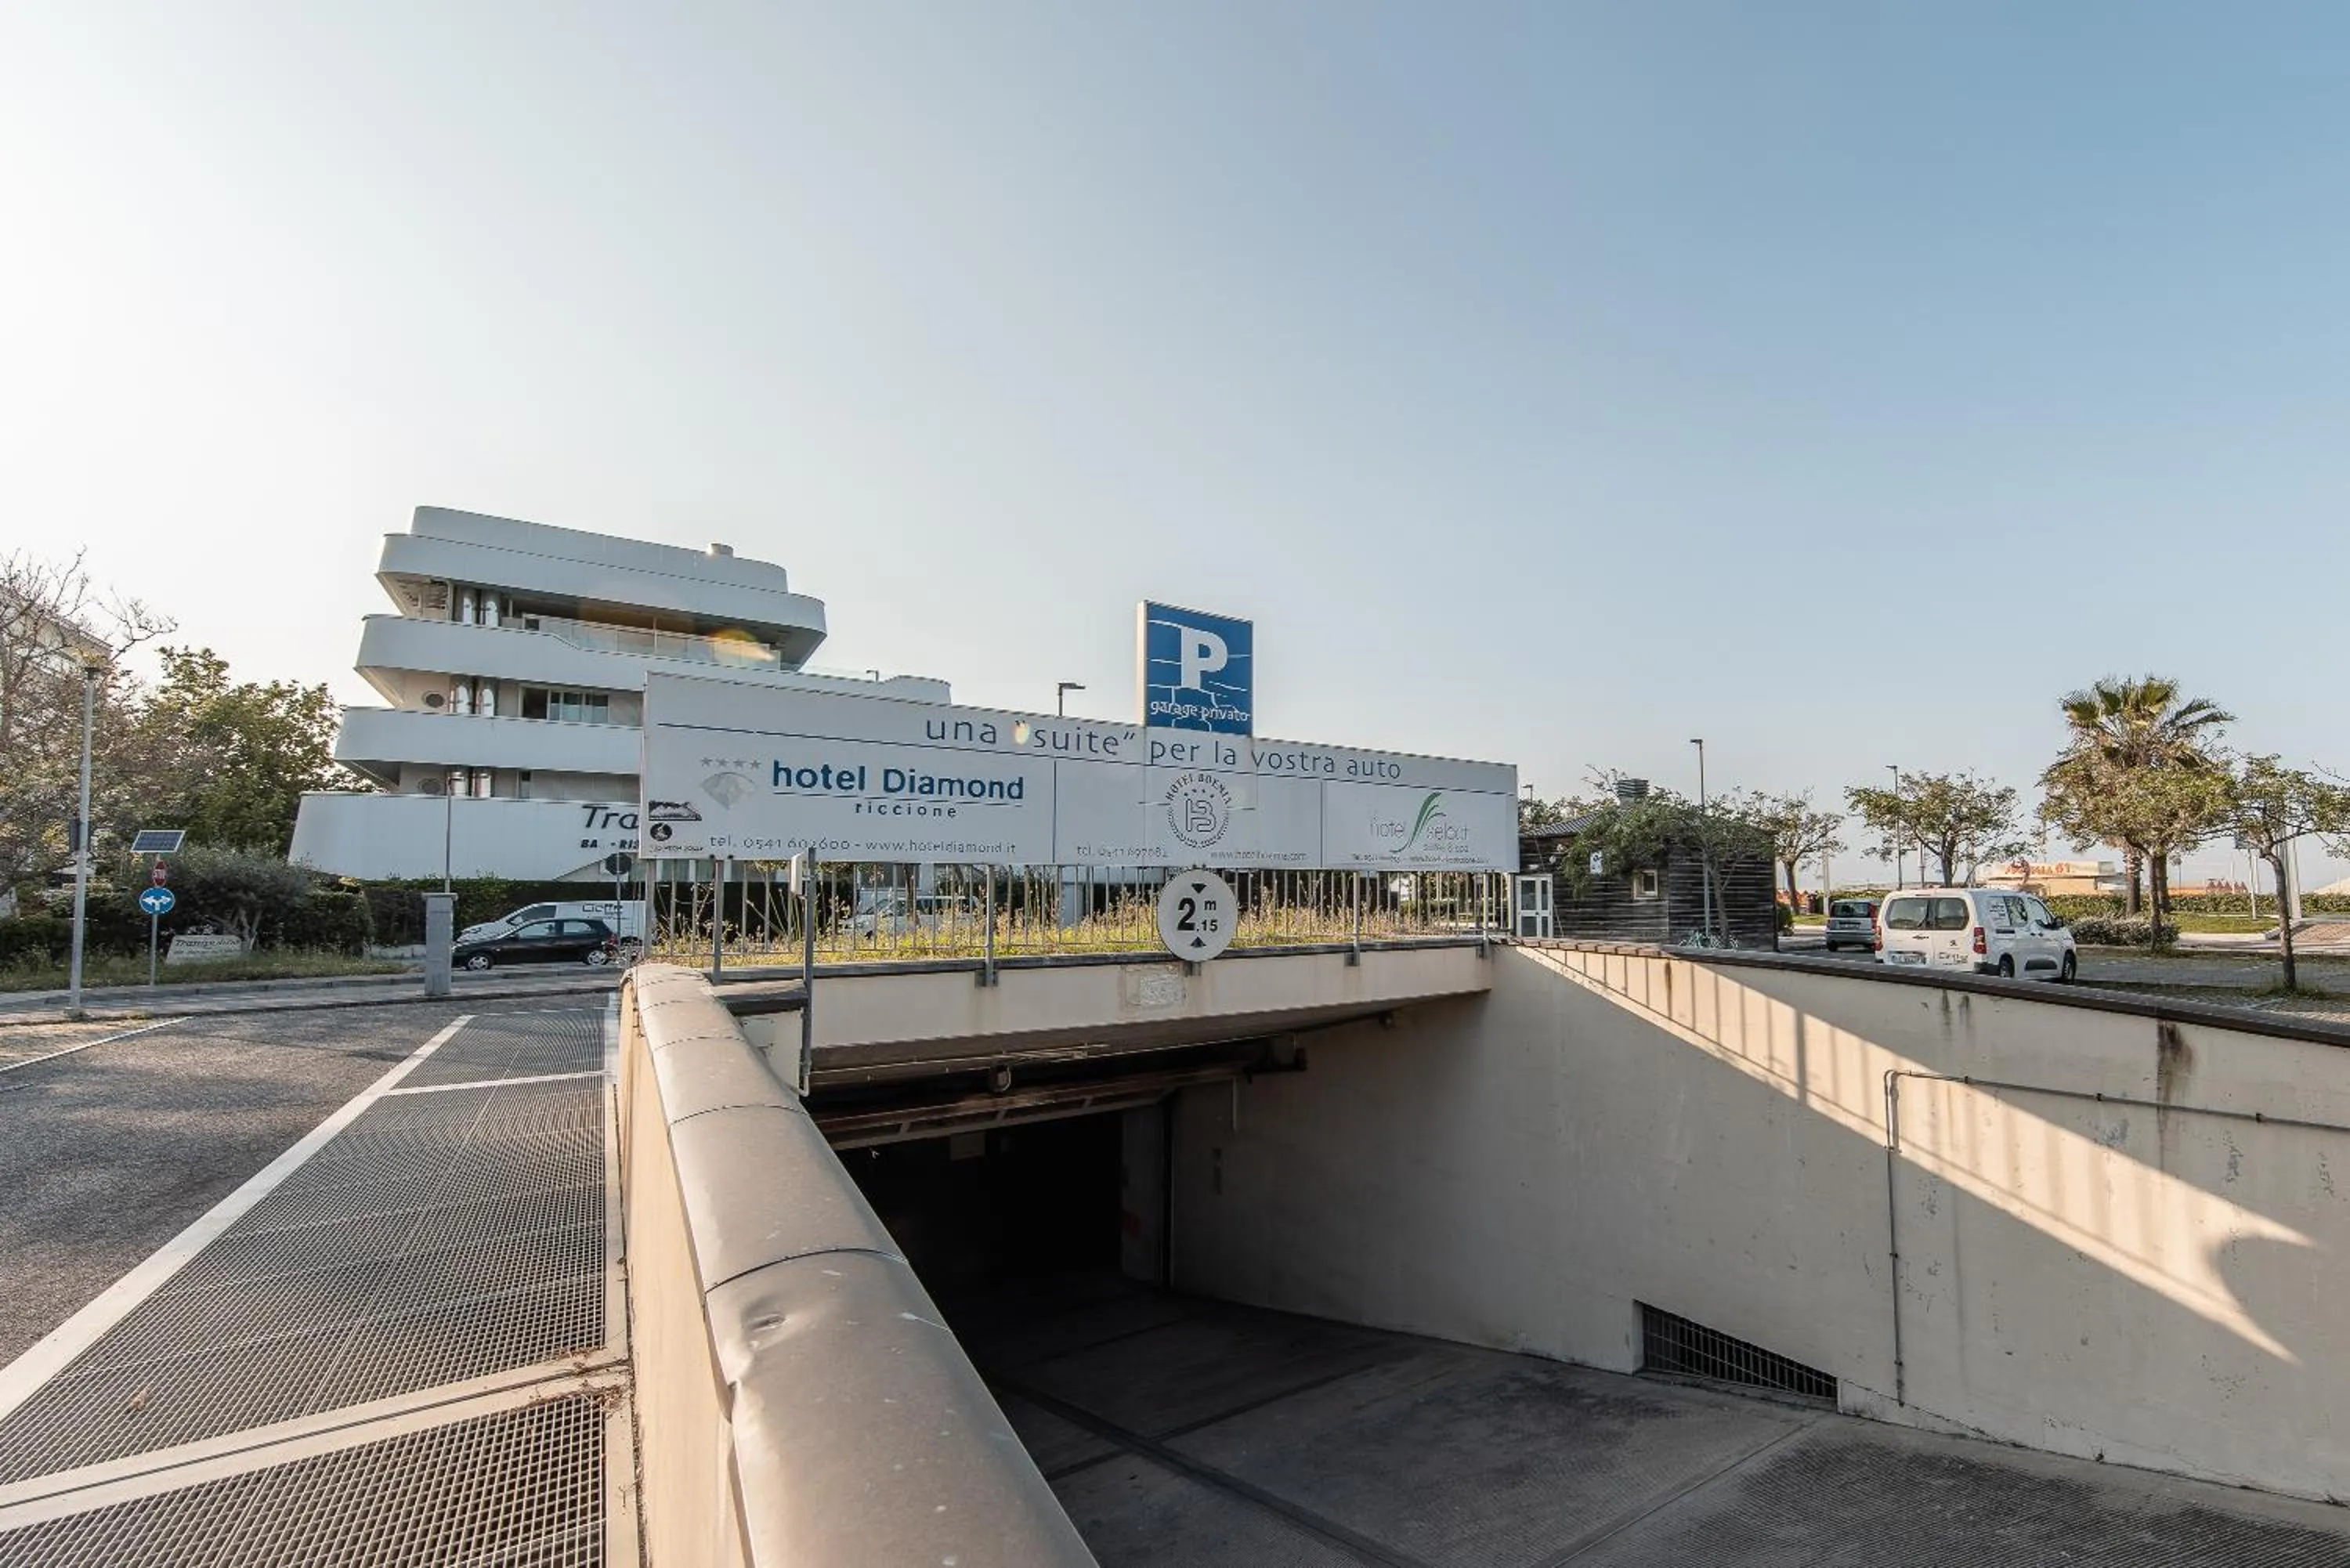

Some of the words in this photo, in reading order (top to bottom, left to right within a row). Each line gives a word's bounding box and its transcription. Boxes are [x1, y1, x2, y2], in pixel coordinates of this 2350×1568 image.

[1180, 626, 1228, 690] P
[1150, 700, 1198, 717] garage
[1198, 705, 1250, 721] privato
[926, 719, 996, 744] una
[1150, 740, 1201, 766] per
[1214, 740, 1236, 765] la
[1251, 750, 1335, 773] vostra
[1346, 758, 1401, 780] auto
[772, 760, 866, 791] hotel
[883, 768, 1024, 800] Diamond
[855, 802, 958, 818] riccione
[710, 834, 737, 847] tel.
[1204, 901, 1217, 911] m
